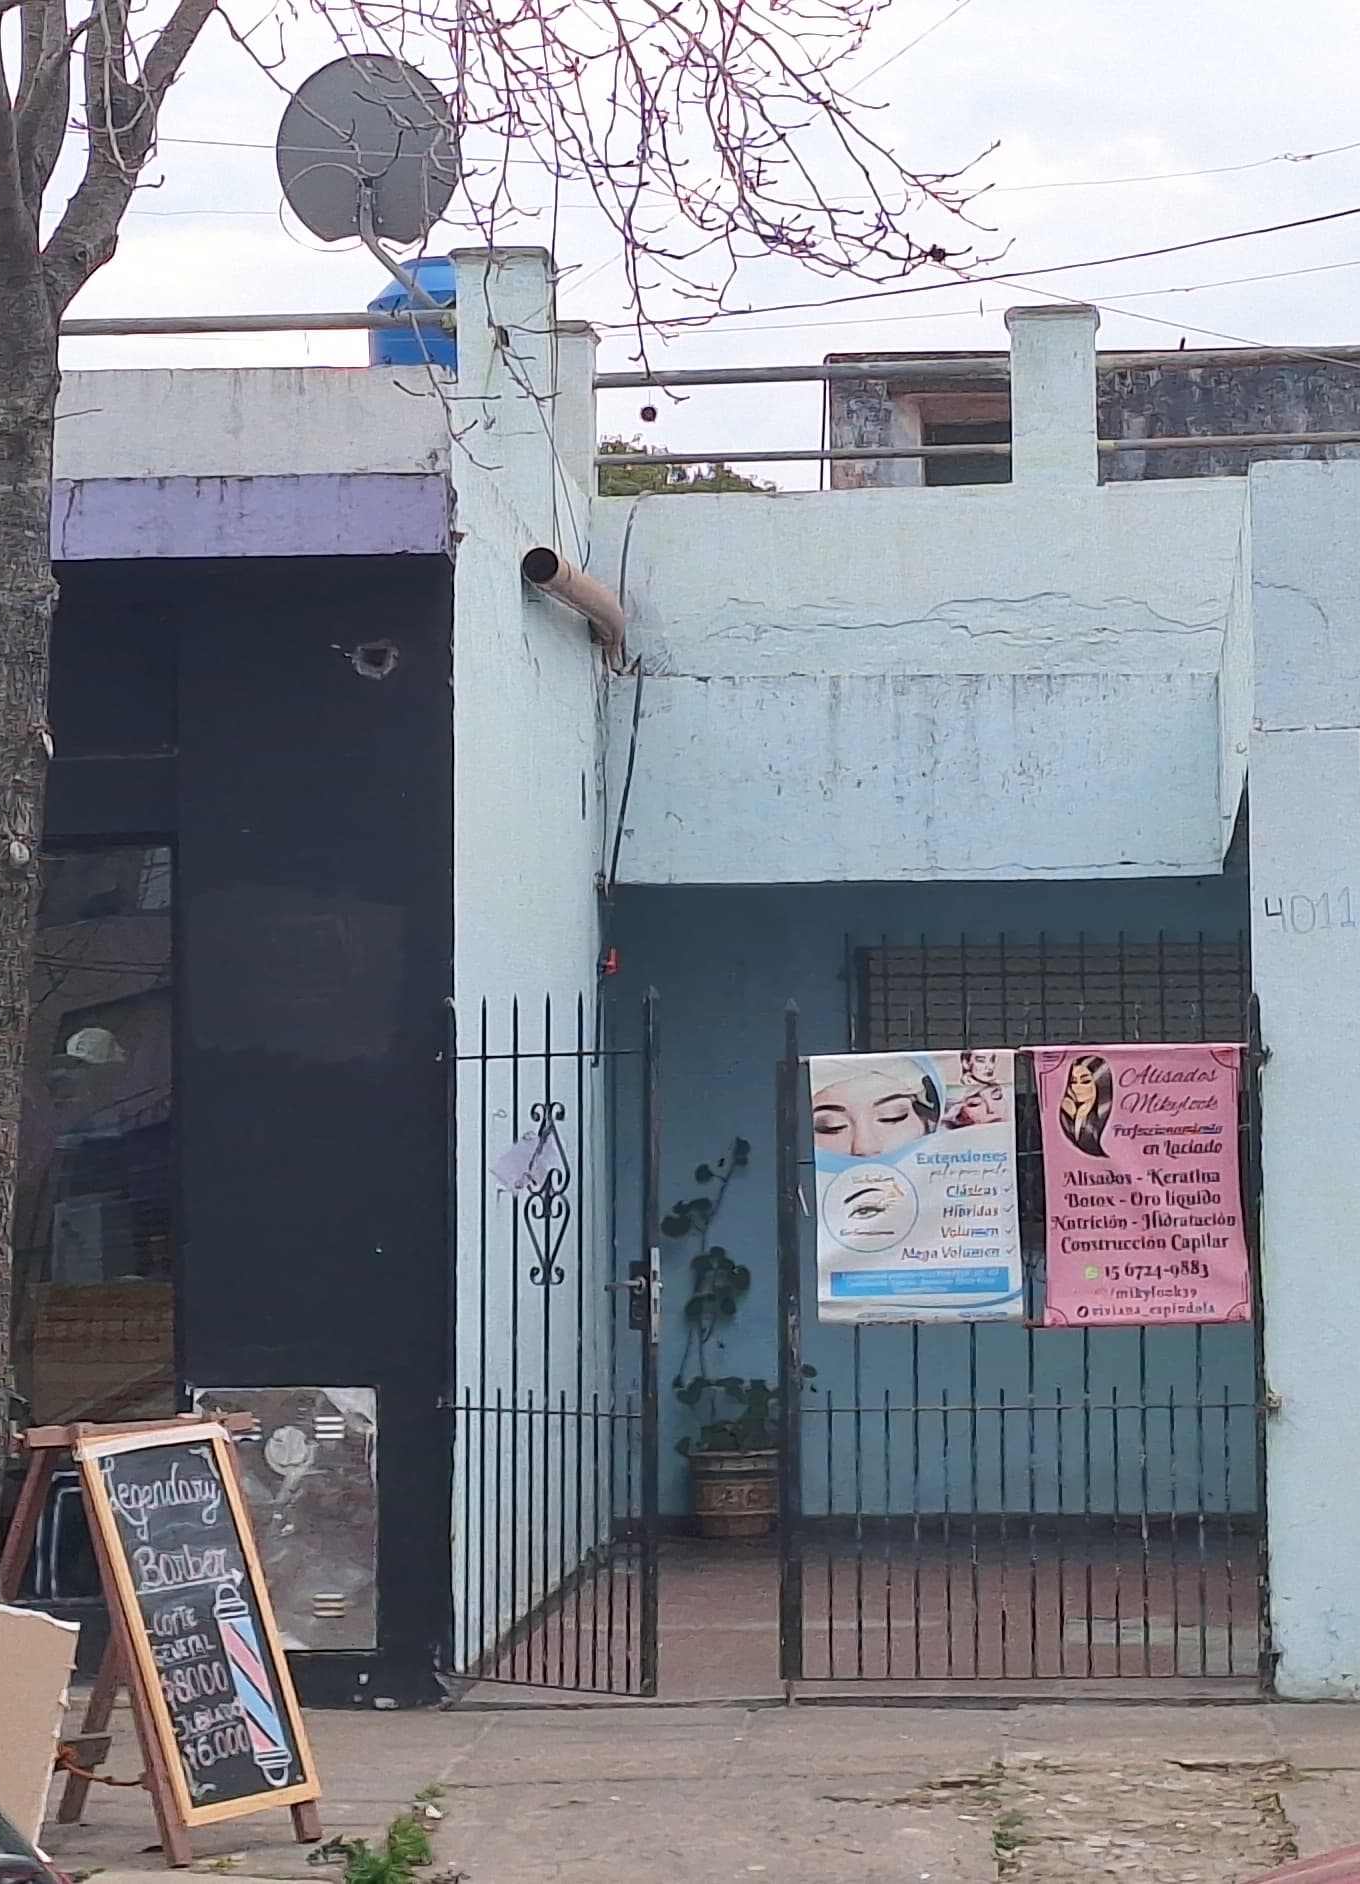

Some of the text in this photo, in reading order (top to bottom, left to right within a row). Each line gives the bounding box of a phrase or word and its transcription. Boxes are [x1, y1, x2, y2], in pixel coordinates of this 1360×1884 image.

[1264, 886, 1356, 934] 4011
[1118, 1064, 1219, 1088] Alisados
[916, 1150, 1008, 1164] Extensiones
[1142, 1139, 1223, 1160] en Laciado
[1063, 1170, 1132, 1187] Alisados
[1147, 1168, 1220, 1186] Keratina
[1130, 1191, 1161, 1206] Oro
[1051, 1214, 1128, 1230] Nutrición
[1141, 1210, 1236, 1230] Hidratación
[941, 1226, 999, 1239] Volumen
[1061, 1232, 1230, 1254] Construcción Capilar
[901, 1246, 1000, 1262] Mega Volumen
[1105, 1265, 1120, 1281] 15
[101, 1457, 221, 1543] Legendary
[133, 1544, 228, 1587] Barber
